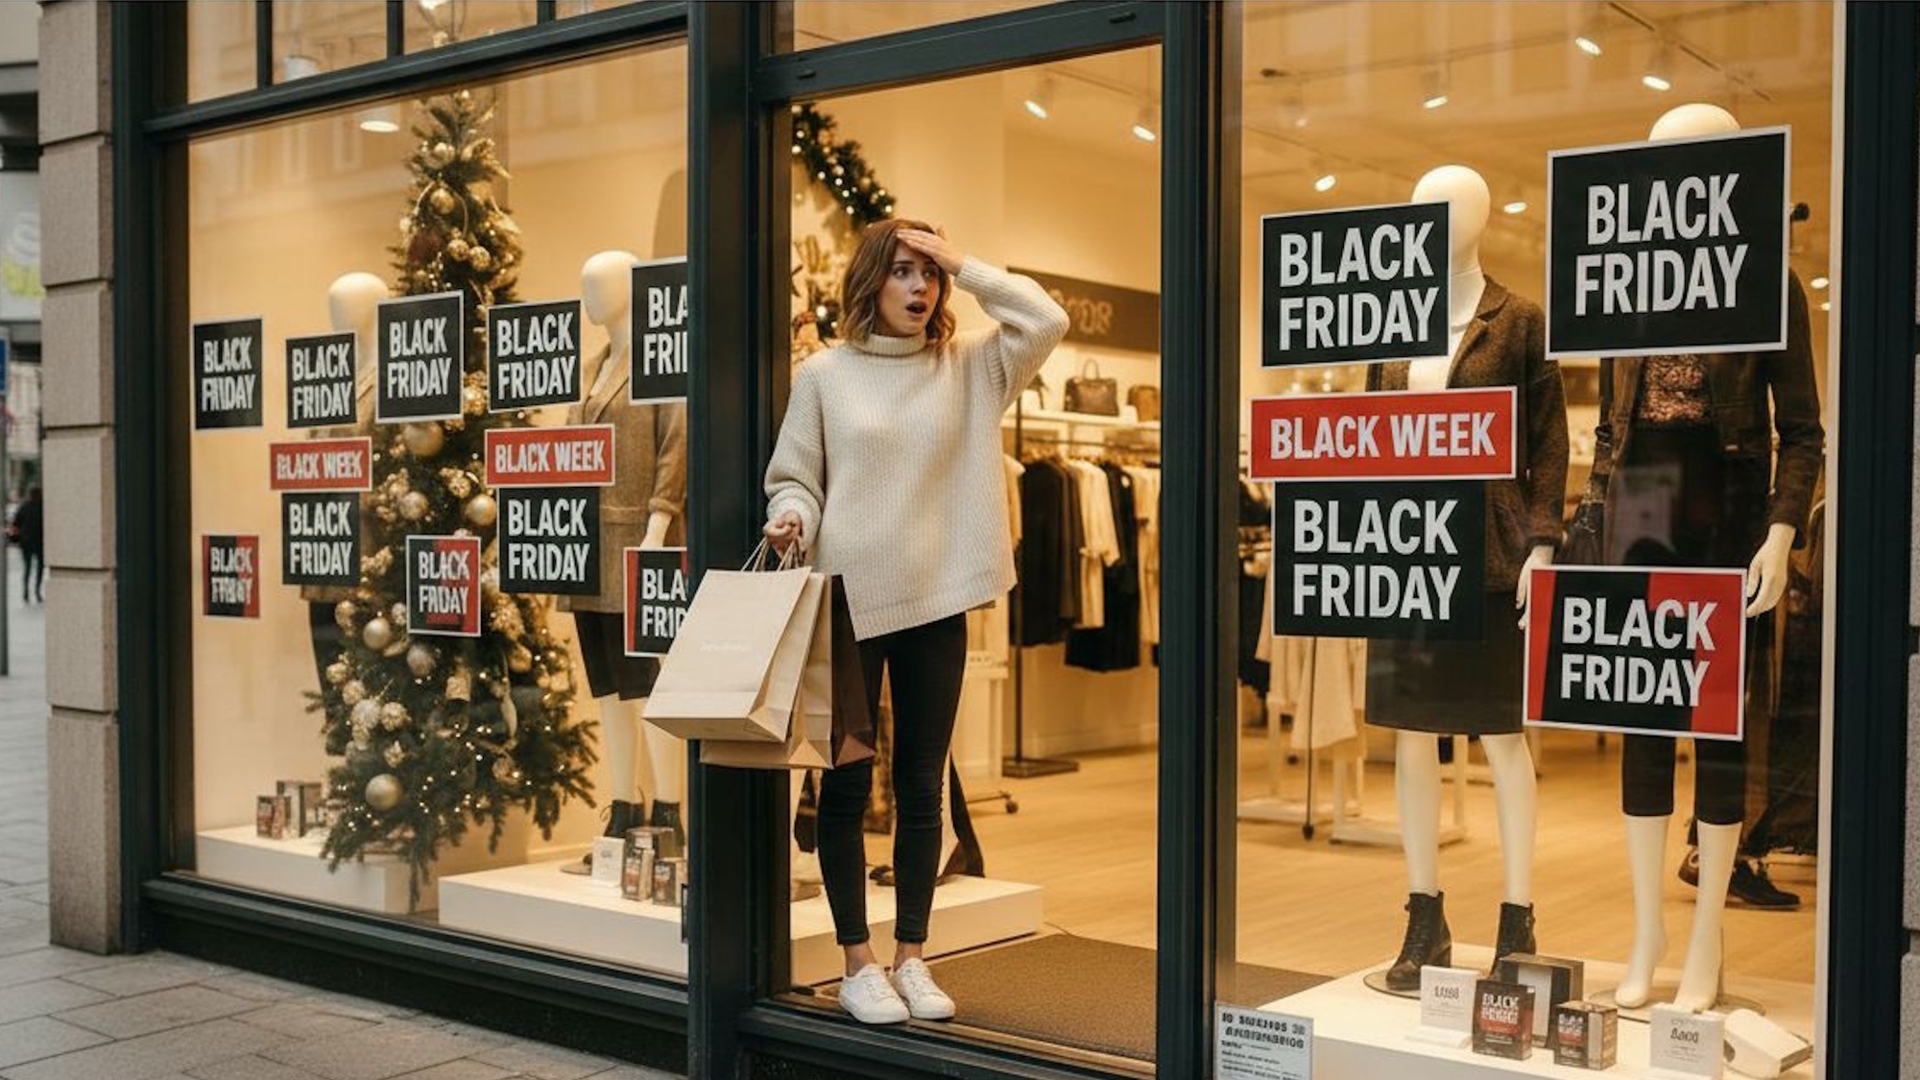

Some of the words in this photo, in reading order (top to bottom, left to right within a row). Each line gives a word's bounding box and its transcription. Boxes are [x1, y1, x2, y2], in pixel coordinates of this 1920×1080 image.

[1588, 174, 1739, 244] BLACK
[1281, 222, 1434, 287] BLACK
[1576, 245, 1748, 315] FRIDAY
[649, 286, 687, 328] BLA
[1280, 287, 1439, 350] FRIDAY
[390, 317, 447, 358] BLACK
[498, 312, 574, 356] BLACK
[644, 332, 687, 375] FRI
[204, 337, 252, 373] BLACK
[293, 343, 350, 381] BLACK
[388, 358, 451, 398] FRIDAY
[499, 356, 576, 399] FRIDAY
[293, 382, 352, 420] FRIDAY
[1271, 416, 1379, 459] BLACK
[1391, 413, 1495, 457] WEEK
[323, 452, 361, 478] WEEK
[496, 443, 550, 473] BLACK
[555, 441, 604, 471] WEEK
[290, 502, 351, 536] BLACK
[509, 499, 586, 536] BLACK
[1295, 499, 1457, 554] BLACK
[290, 542, 352, 575] FRIDAY
[419, 551, 469, 580] BLACK
[509, 544, 589, 581] FRIDAY
[643, 569, 687, 601] BLA
[1294, 564, 1461, 619] FRIDAY
[1563, 598, 1717, 650] BLACK
[1561, 654, 1710, 706] FRIDAY
